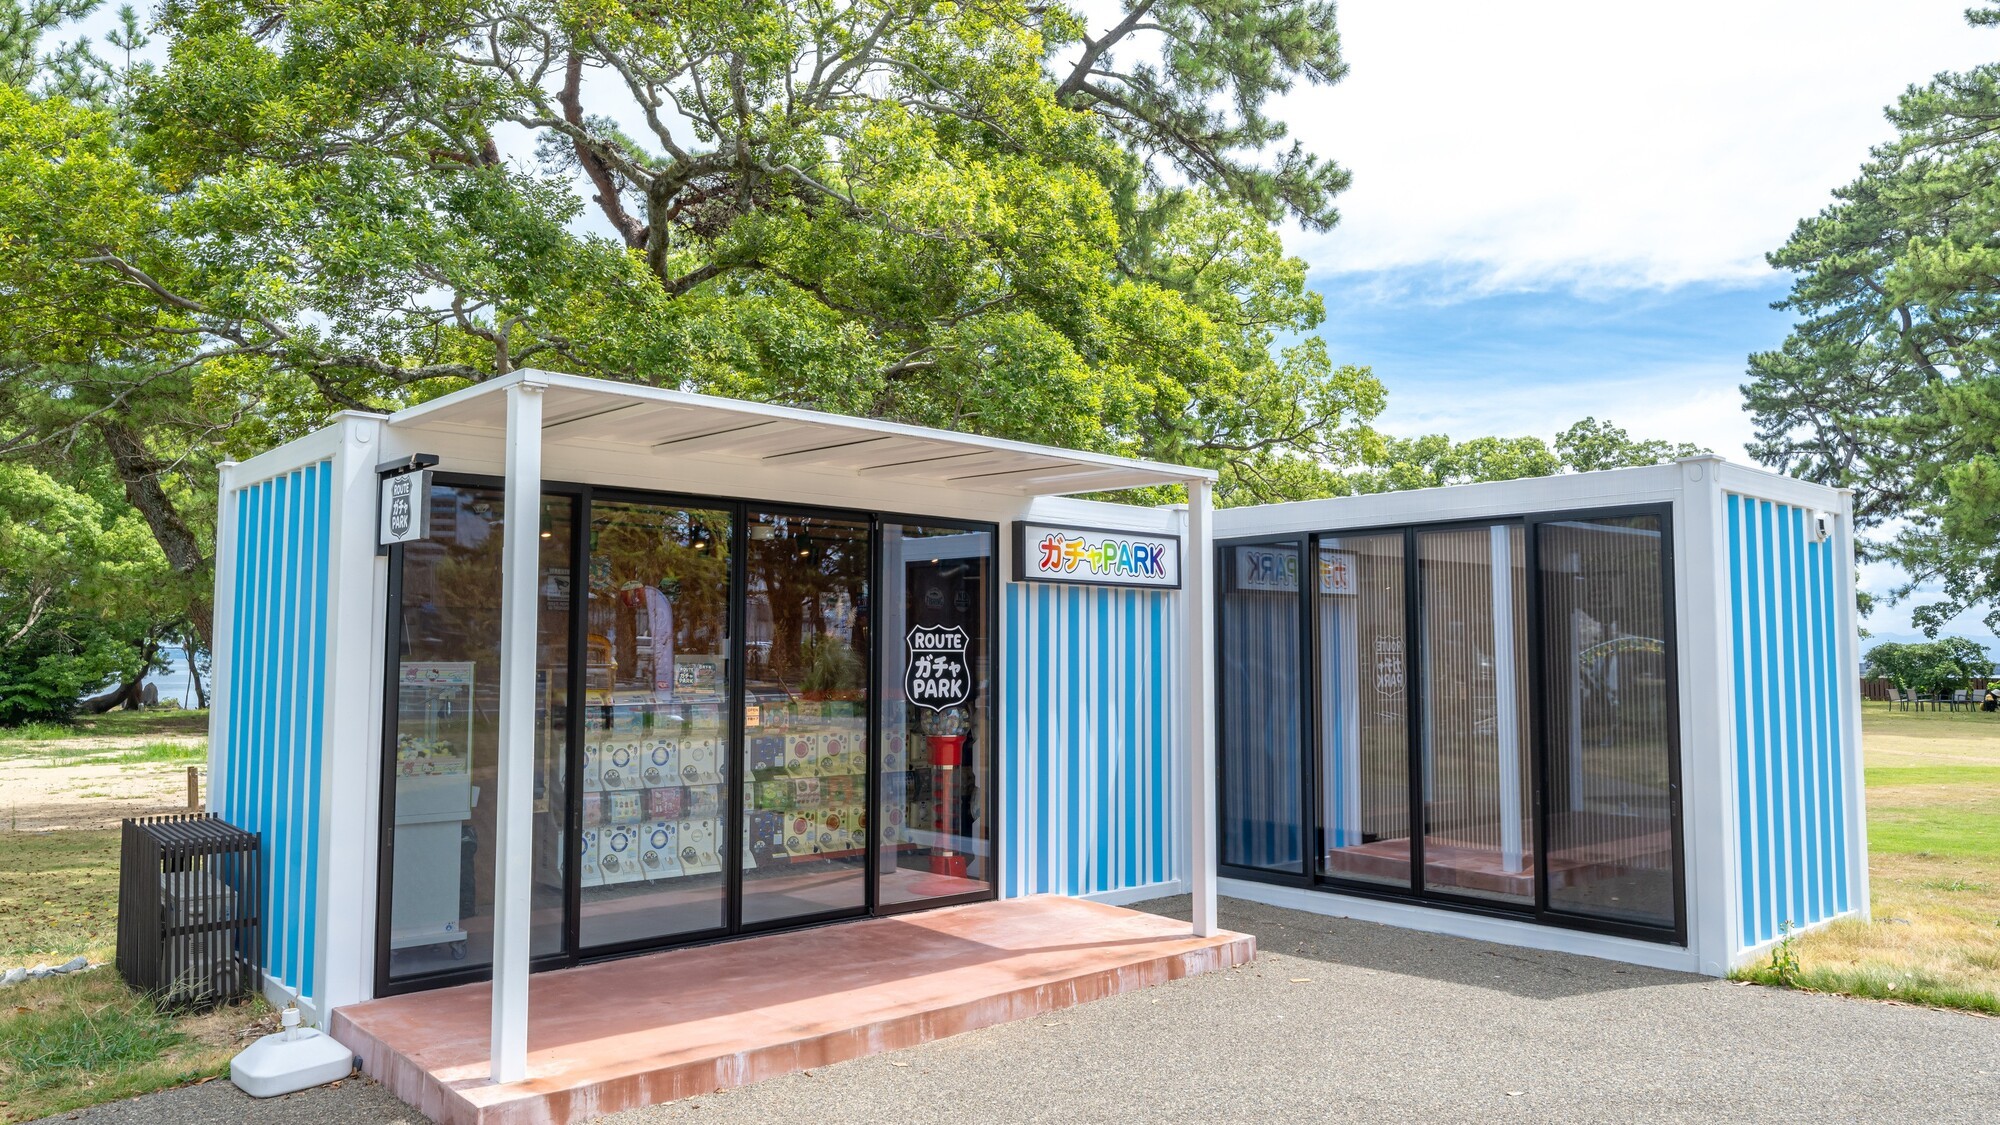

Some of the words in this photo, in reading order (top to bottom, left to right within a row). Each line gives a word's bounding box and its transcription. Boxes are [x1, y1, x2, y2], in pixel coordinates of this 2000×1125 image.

[394, 483, 409, 495] ROUTE
[393, 499, 409, 515] ガチャ
[392, 515, 408, 529] PARK
[1039, 534, 1165, 577] ガチャPARK
[914, 631, 962, 649] ROUTE
[914, 653, 961, 678] ガチャ
[913, 678, 962, 699] PARK
